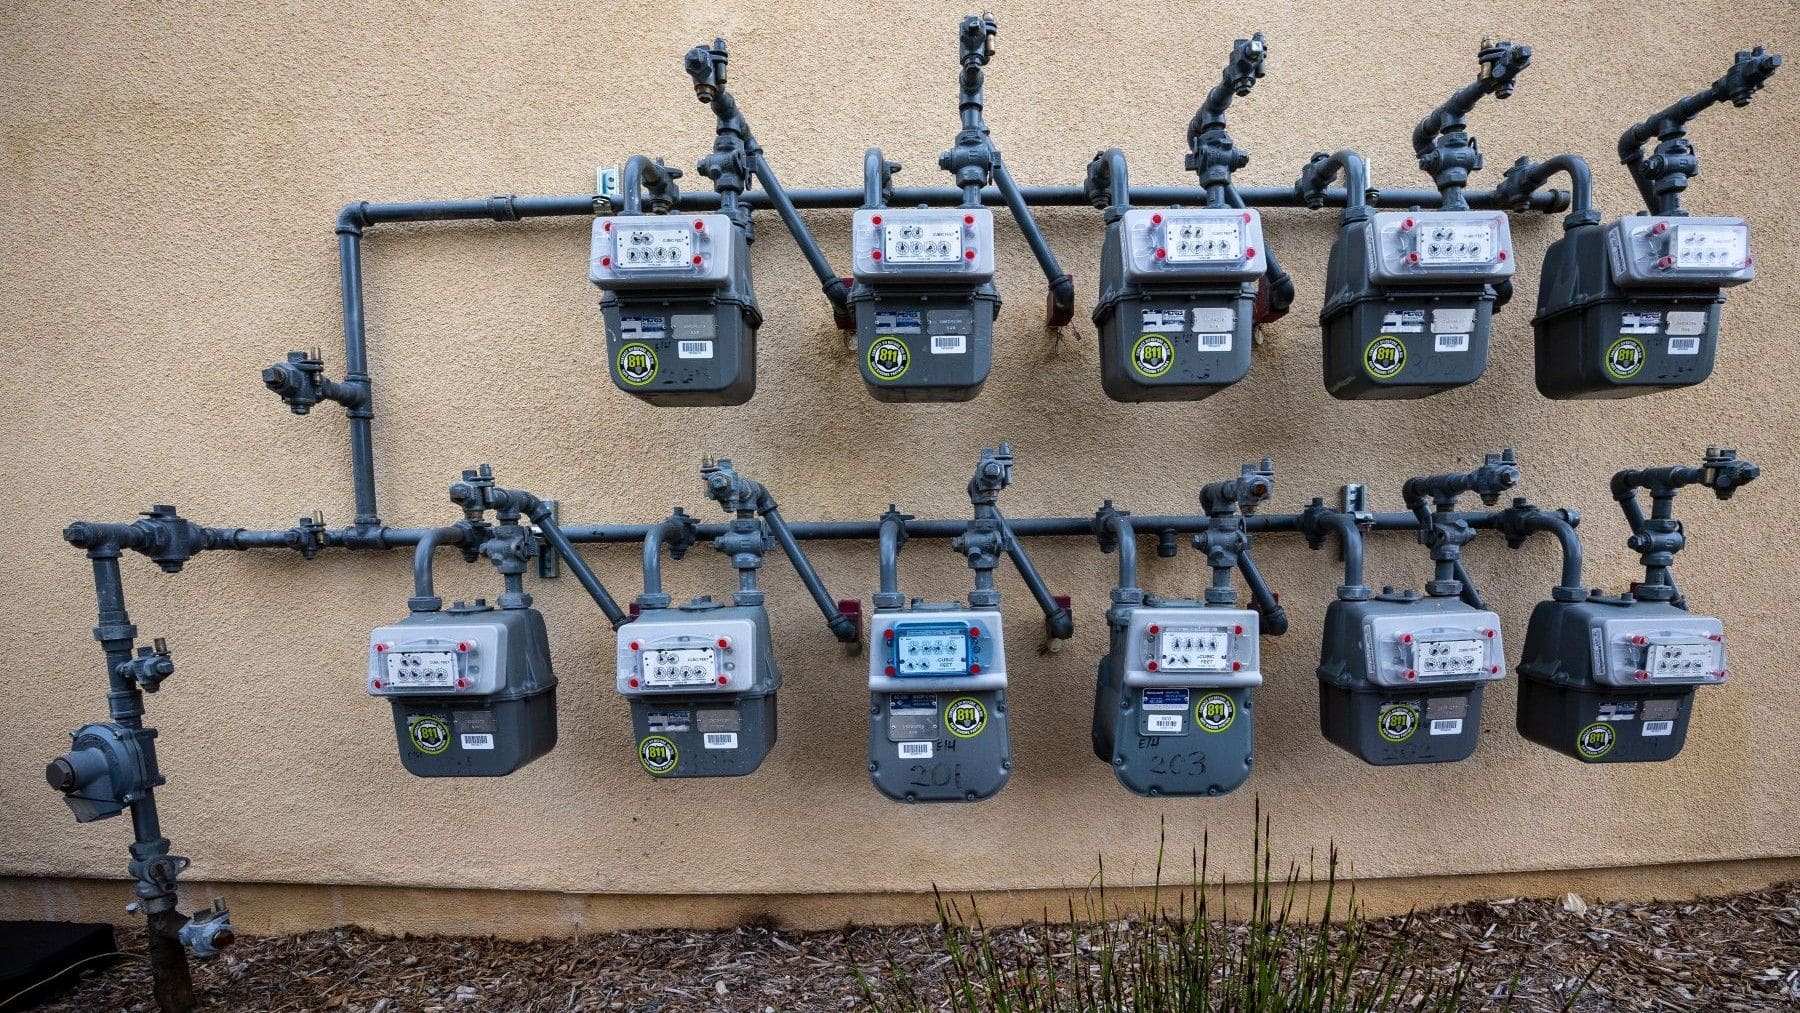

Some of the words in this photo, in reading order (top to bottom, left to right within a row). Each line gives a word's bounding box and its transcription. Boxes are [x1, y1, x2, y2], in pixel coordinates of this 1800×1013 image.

[880, 348, 898, 362] 811
[1144, 346, 1162, 359] 811
[1378, 347, 1395, 360] 811
[1618, 348, 1634, 361] 811
[628, 354, 646, 368] 811
[957, 708, 974, 720] 811
[1207, 703, 1223, 716] 811
[1390, 716, 1406, 726] 811
[421, 728, 438, 738] 811
[1589, 733, 1605, 743] 811
[649, 746, 666, 758] 811
[1150, 751, 1206, 776] 203
